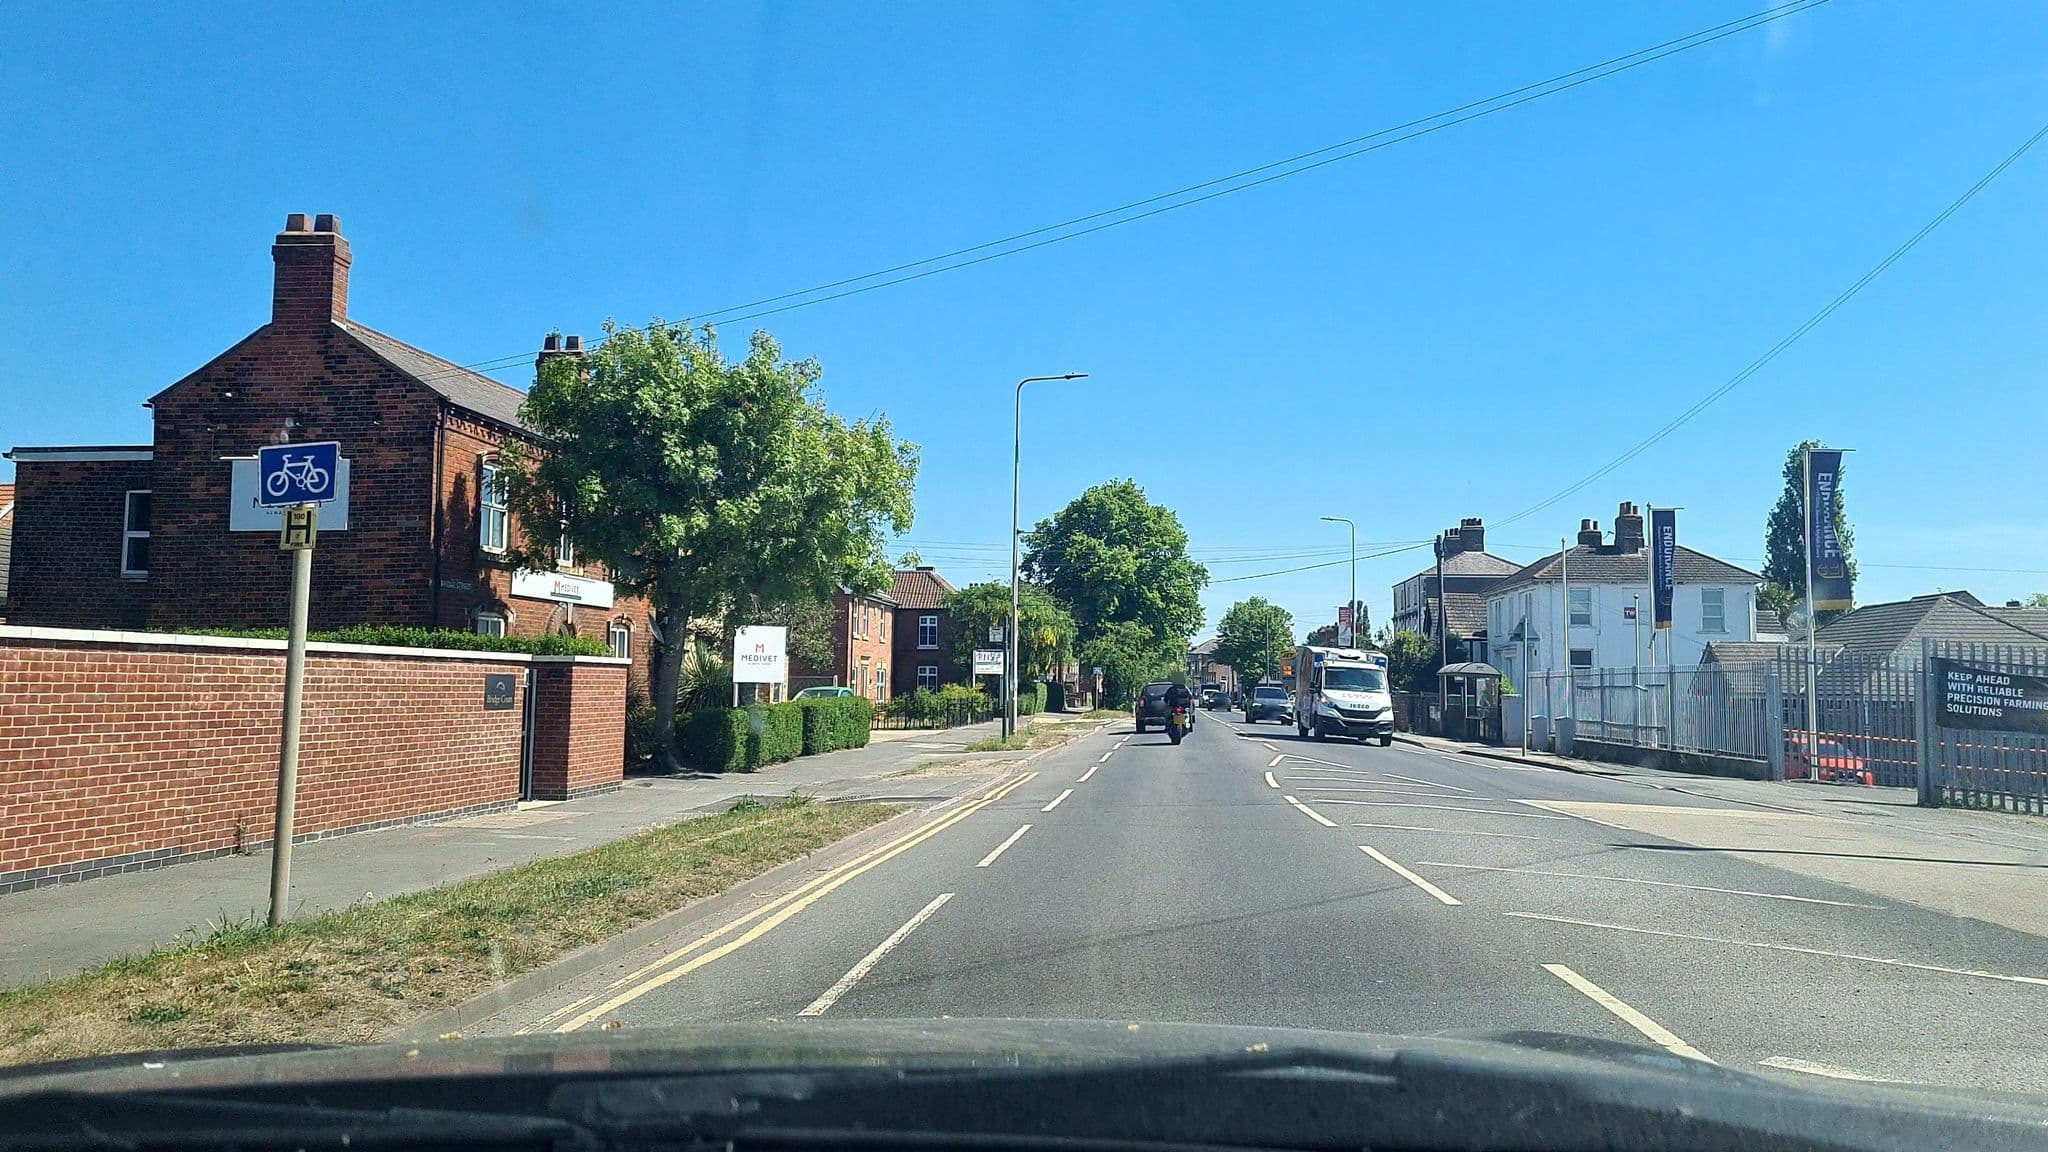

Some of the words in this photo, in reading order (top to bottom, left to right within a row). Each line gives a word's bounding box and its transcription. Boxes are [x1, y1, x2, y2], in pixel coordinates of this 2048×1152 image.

[741, 654, 778, 662] MEDIVET
[1948, 672, 1972, 681] KEEP
[1975, 675, 2010, 685] AHEAD
[1948, 682, 1974, 692] WITH
[1978, 686, 2024, 697] RELIABLE
[1947, 693, 2000, 706] PRECISION
[2003, 699, 2048, 710] FARMING
[1947, 703, 2002, 717] SOLUTIONS
